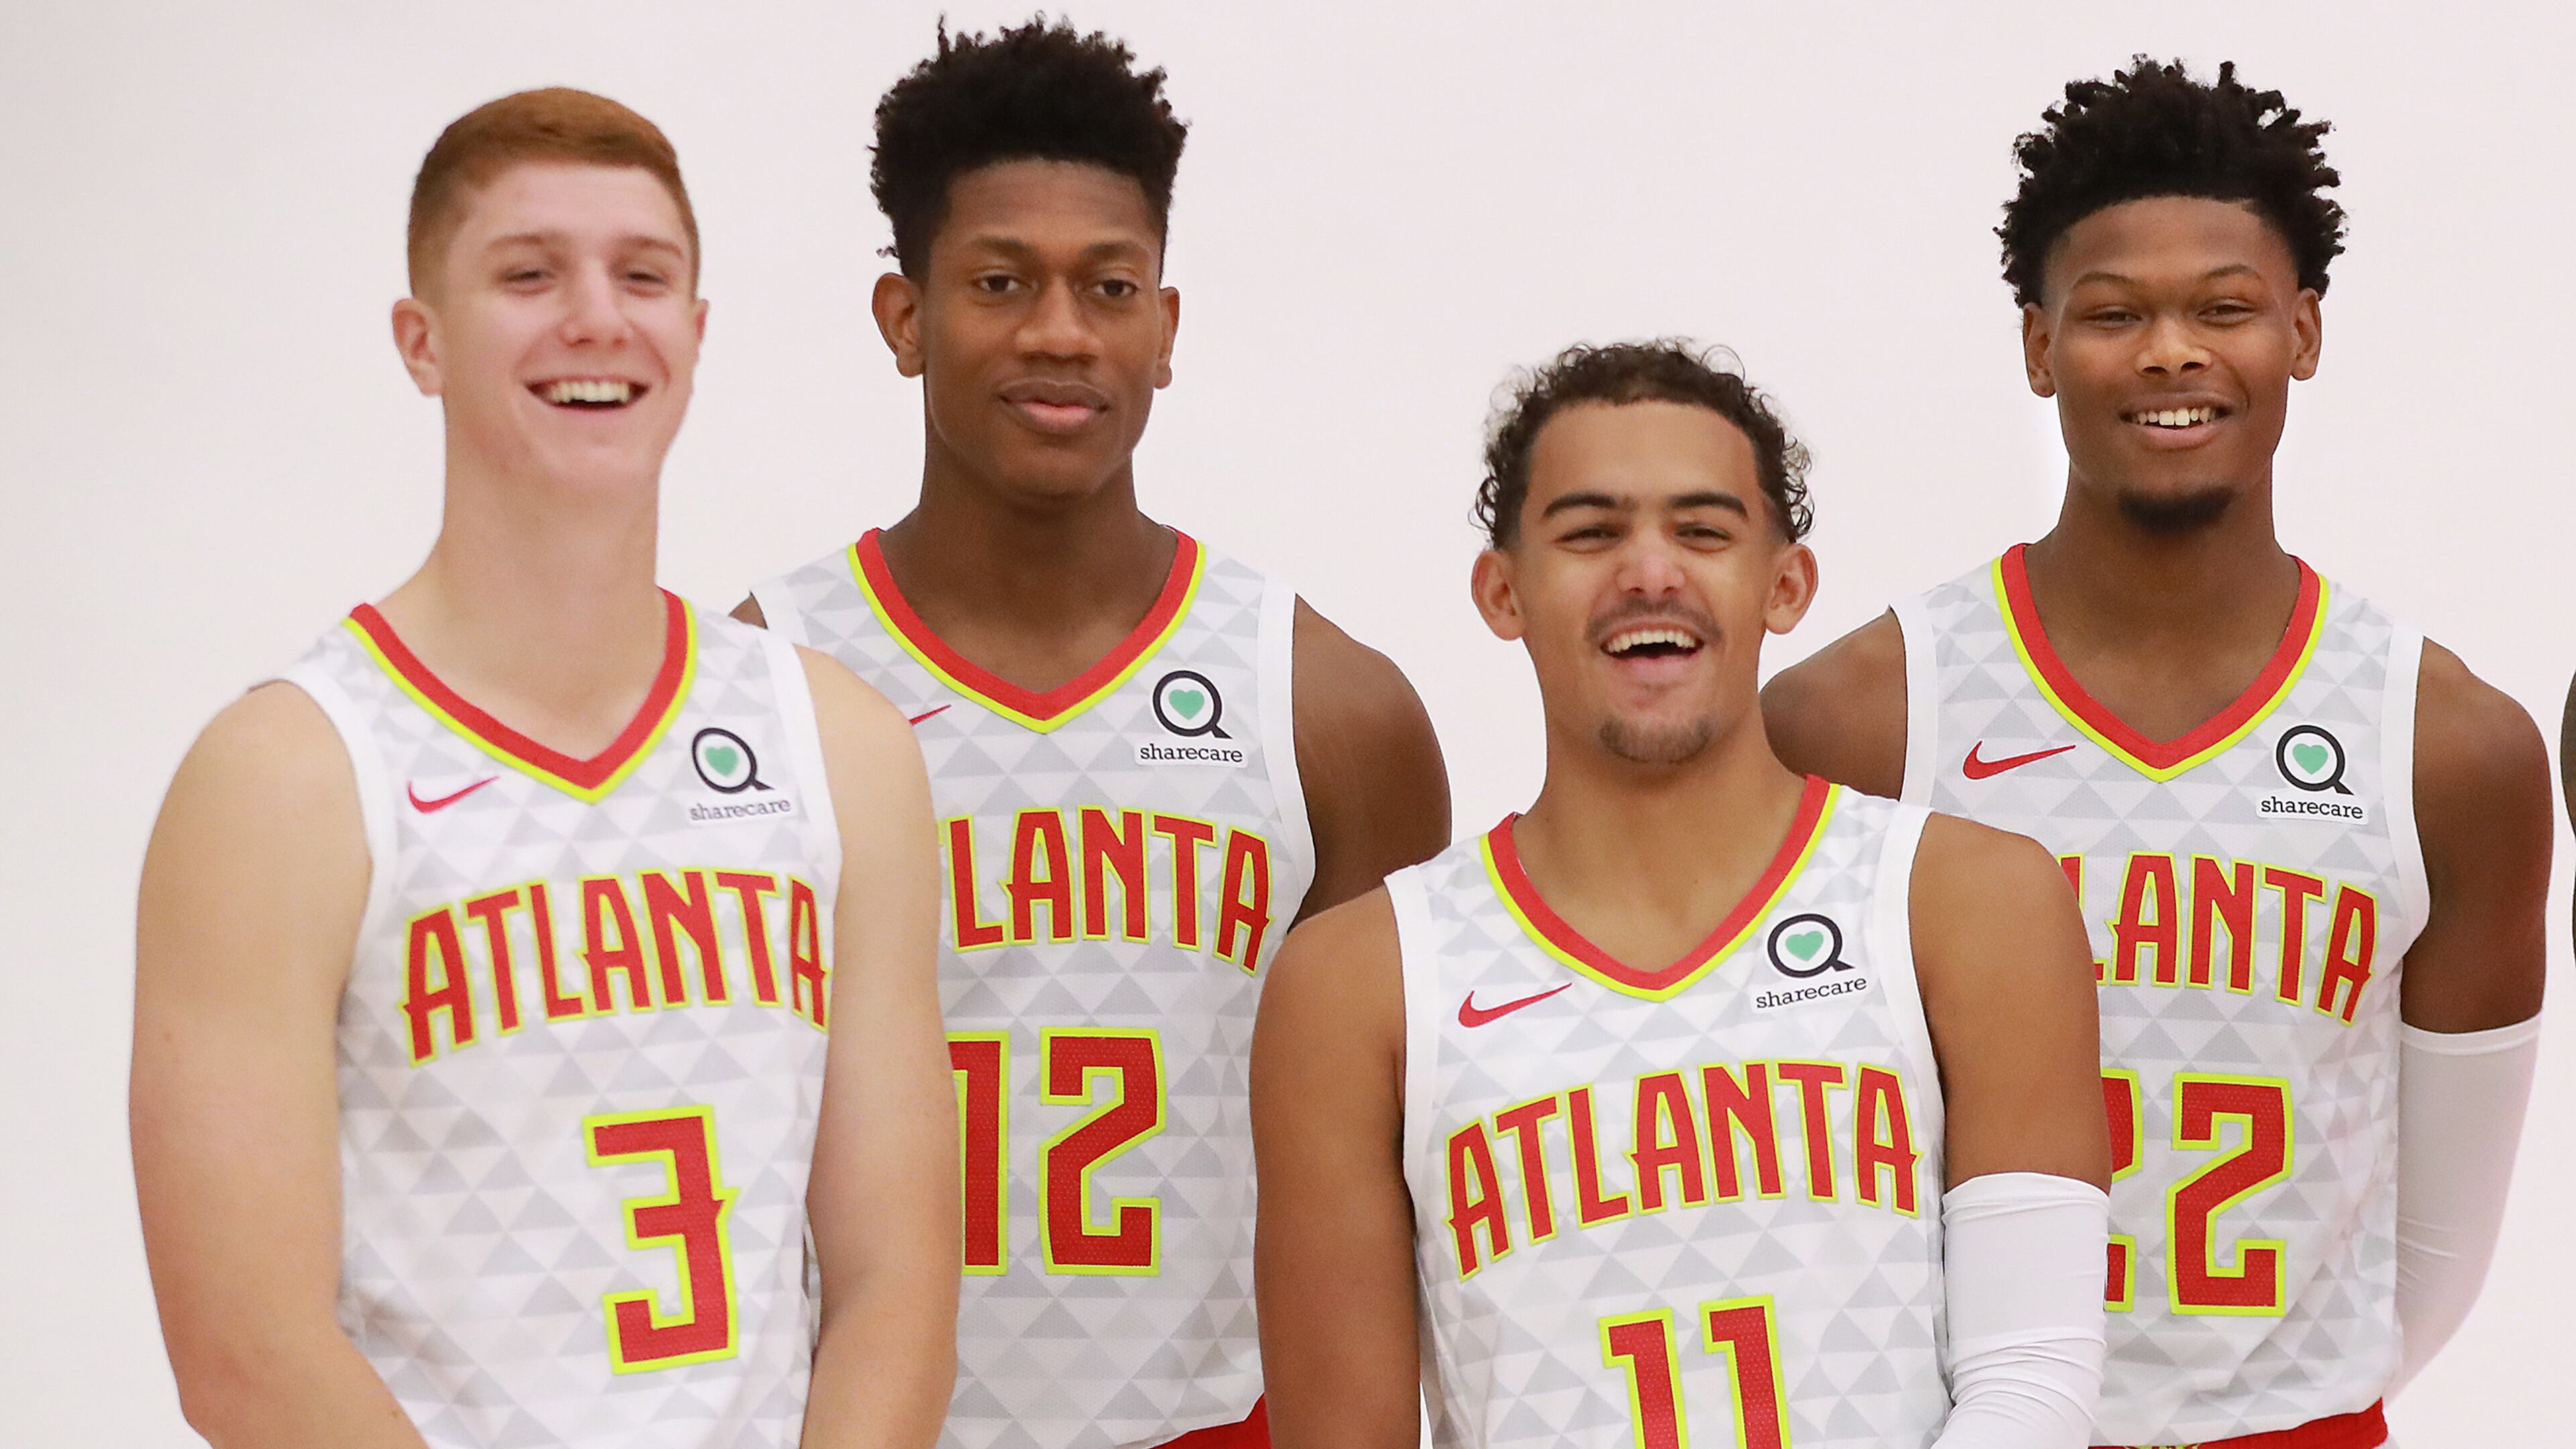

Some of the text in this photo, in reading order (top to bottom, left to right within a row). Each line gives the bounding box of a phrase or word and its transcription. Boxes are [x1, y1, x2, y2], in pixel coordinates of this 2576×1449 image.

[690, 800, 791, 820] sharecare
[1140, 743, 1242, 762] sharecare
[2261, 796, 2363, 819] sharecare
[398, 867, 833, 1068] ATLANTA
[936, 804, 1275, 977] LANTA
[1756, 977, 1867, 1008] sharecare
[945, 1026, 1167, 1276] 12
[1444, 1059, 1923, 1282] ATLANTA
[582, 1106, 741, 1375] 3
[1599, 1294, 1791, 1449] 11
